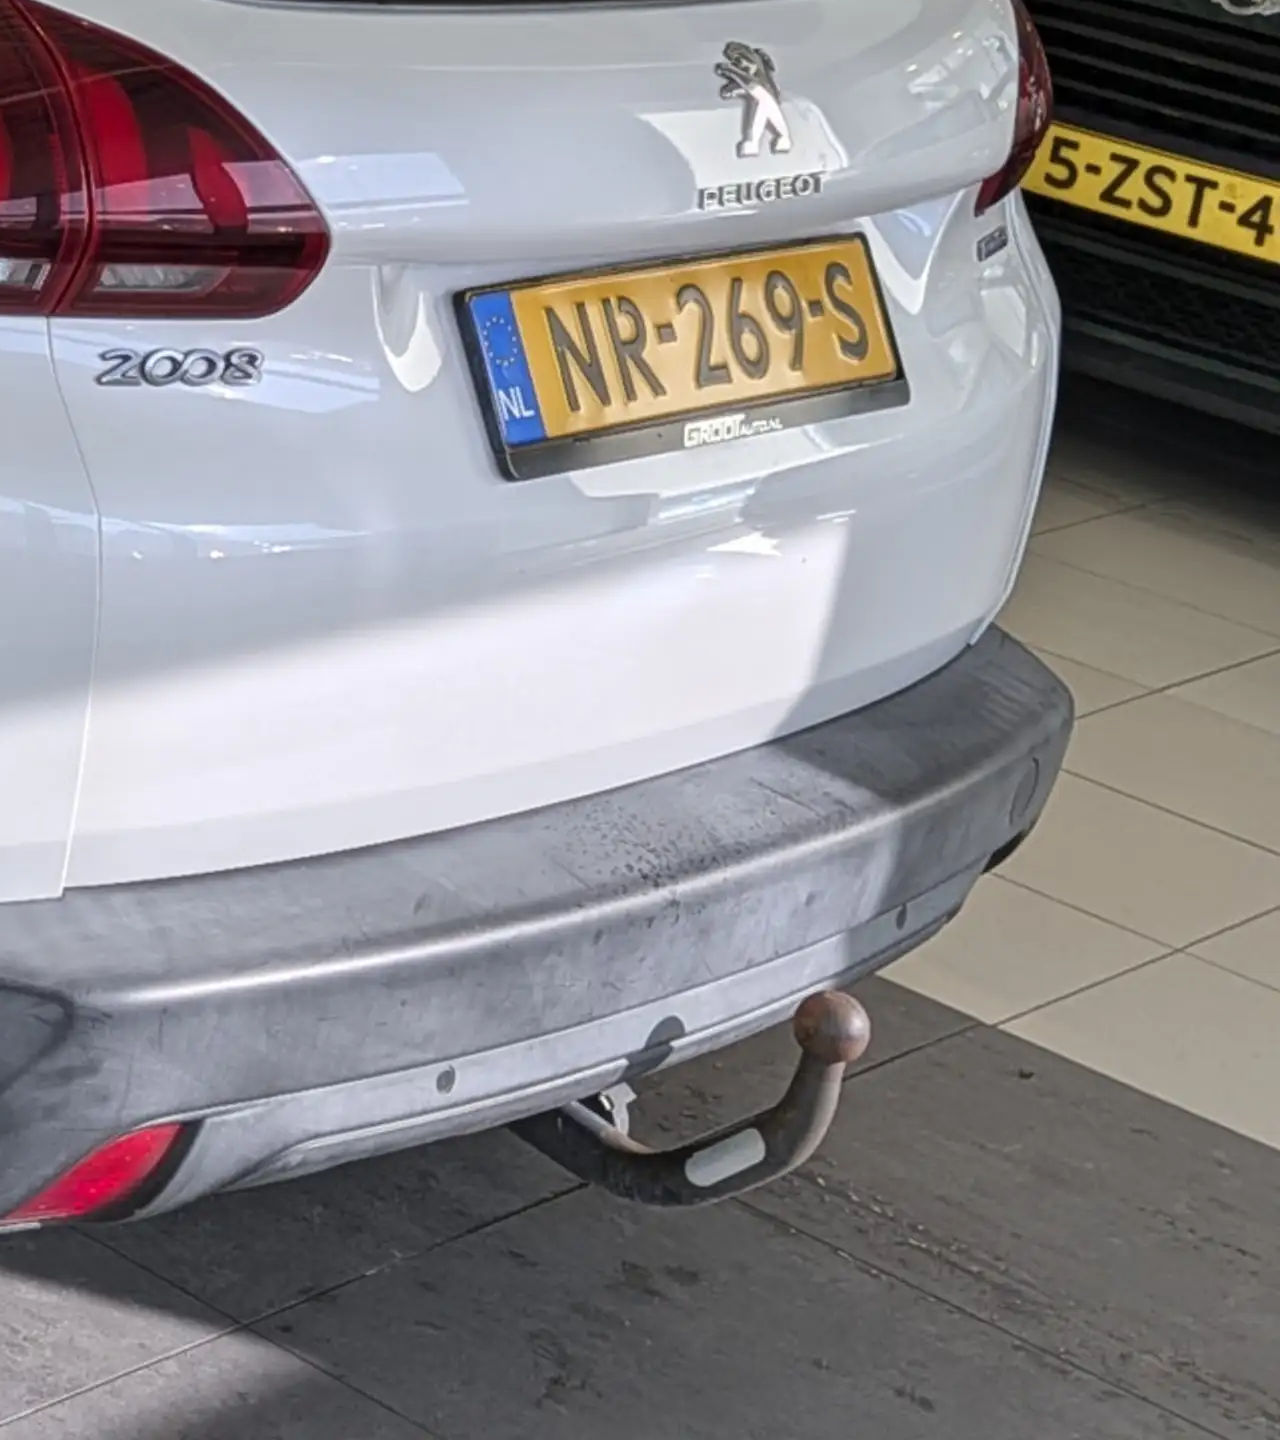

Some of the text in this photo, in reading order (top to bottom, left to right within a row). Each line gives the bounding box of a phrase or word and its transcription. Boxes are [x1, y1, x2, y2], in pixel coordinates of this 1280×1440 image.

[698, 170, 827, 212] PEUGEOT
[1043, 135, 1275, 247] 5-ZST-4
[544, 261, 870, 413] NR-269-S
[95, 347, 265, 387] 2008
[498, 386, 535, 420] NL
